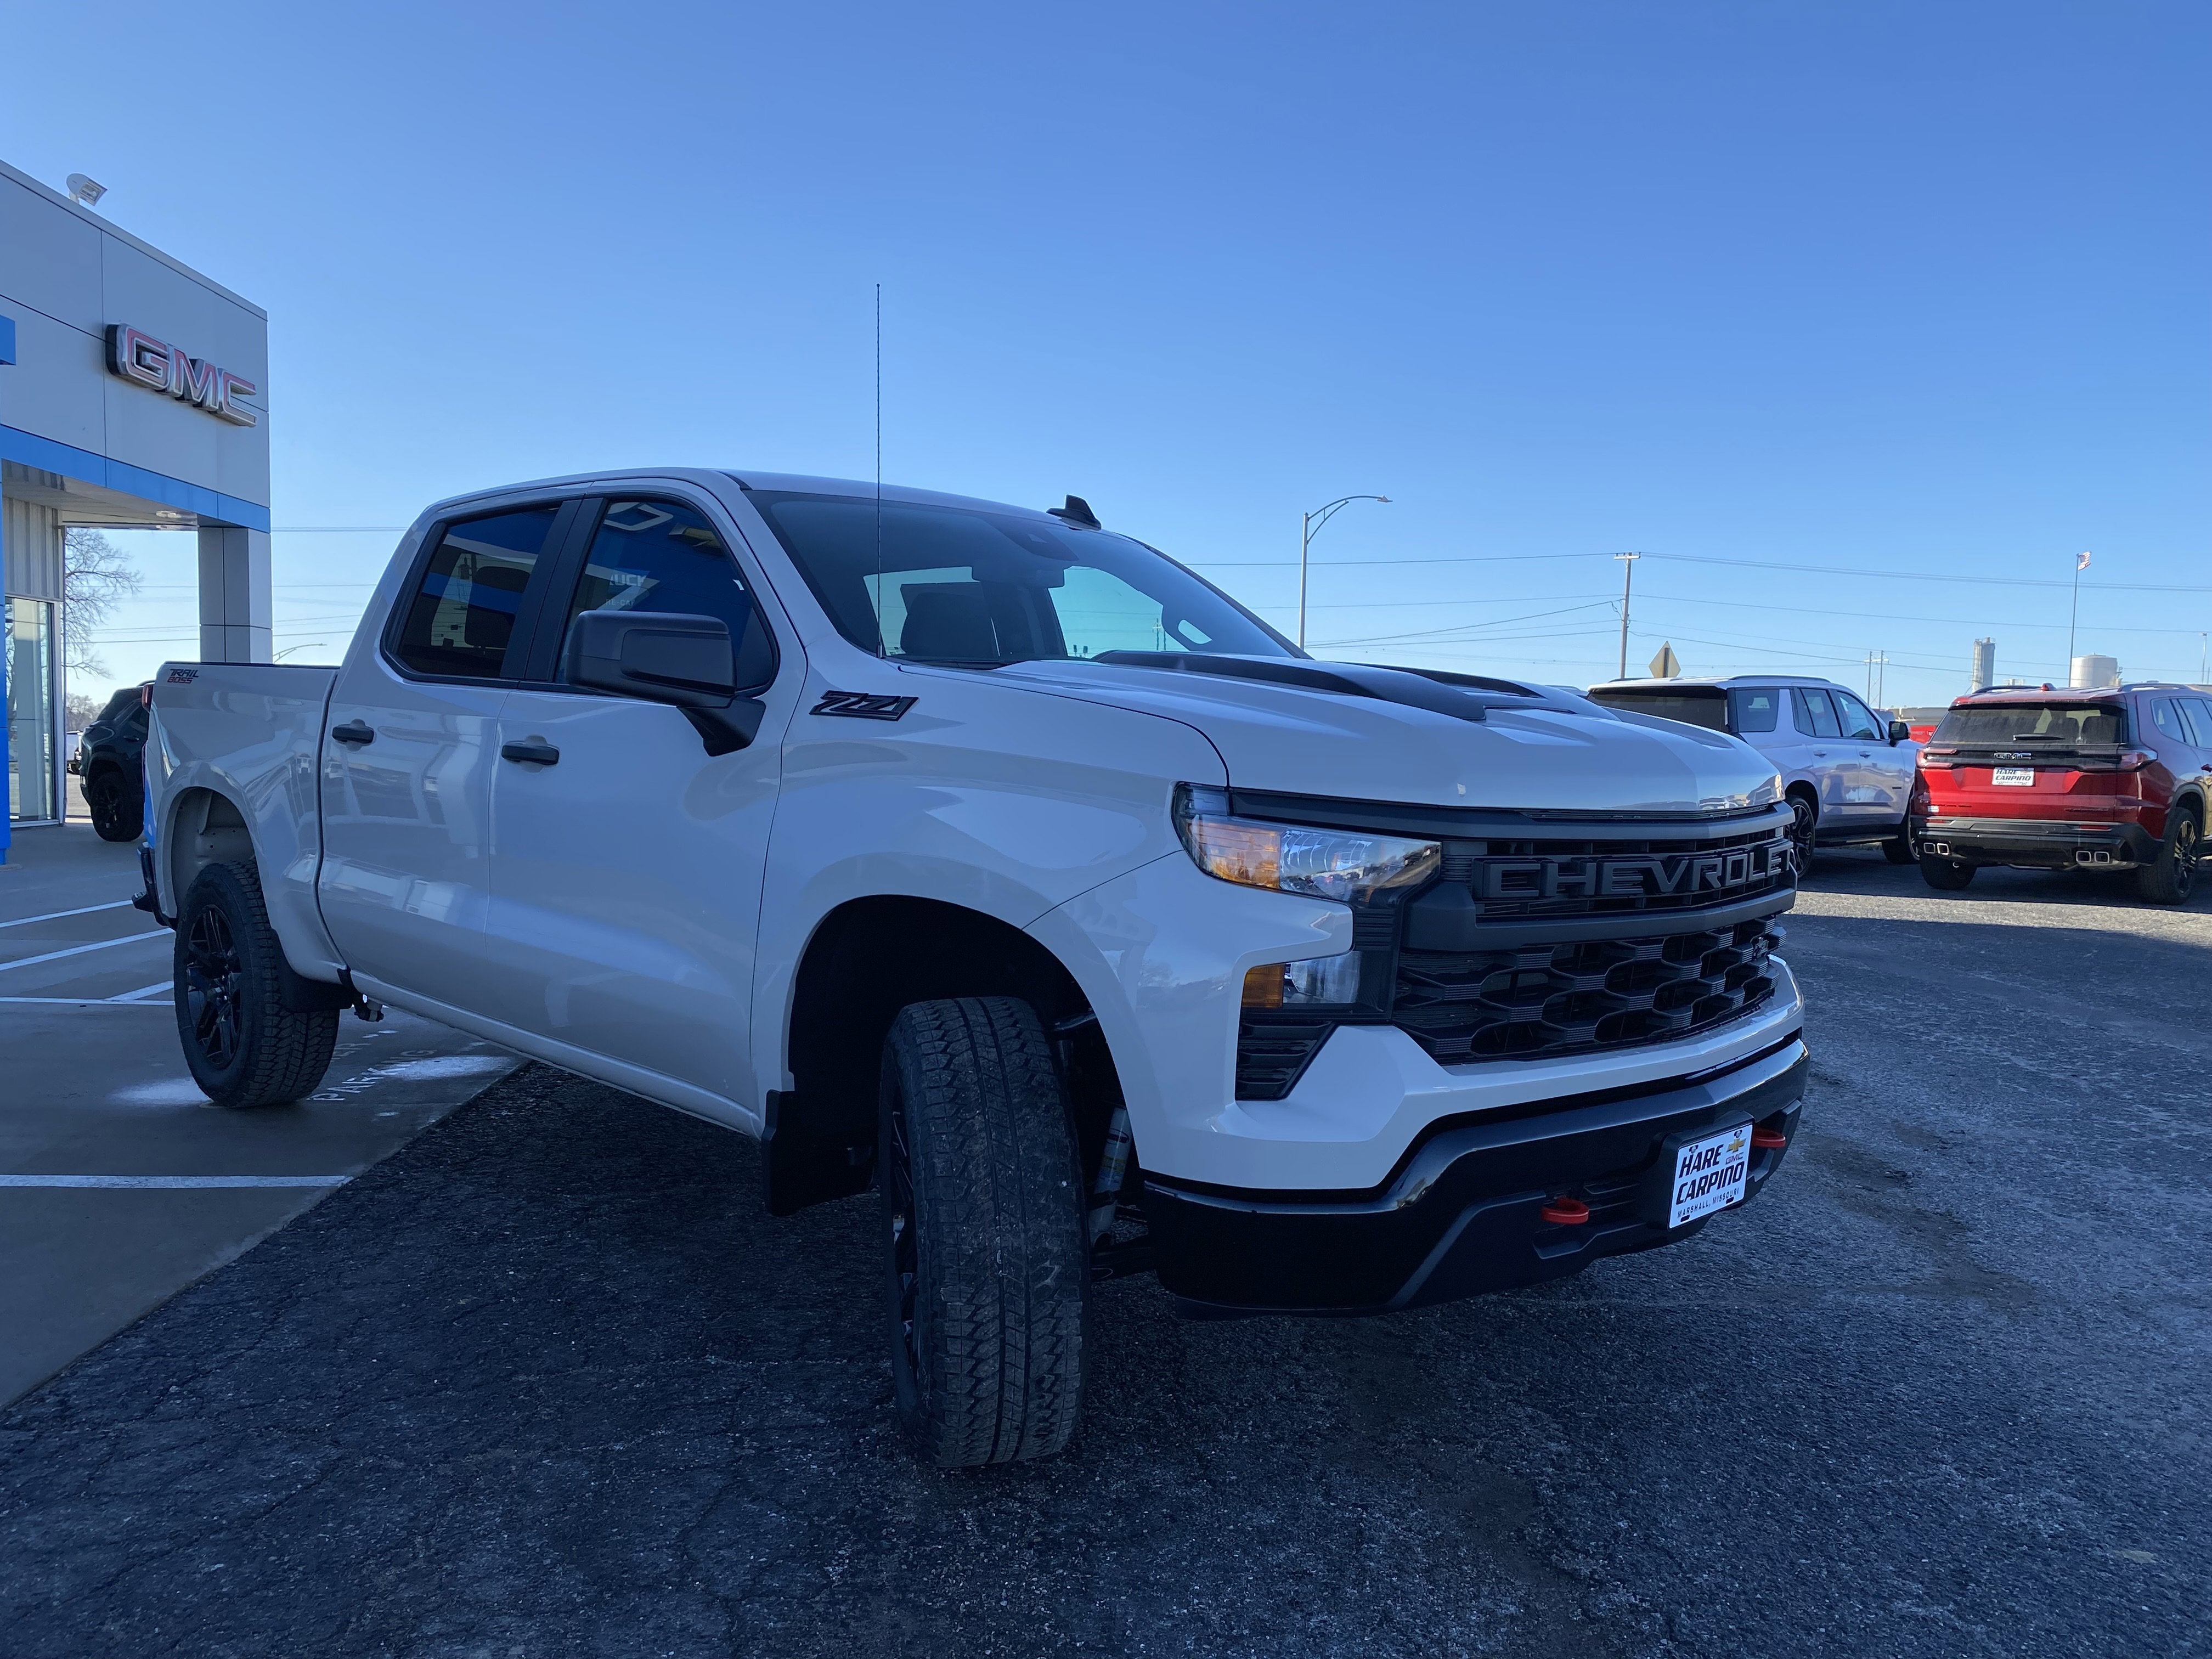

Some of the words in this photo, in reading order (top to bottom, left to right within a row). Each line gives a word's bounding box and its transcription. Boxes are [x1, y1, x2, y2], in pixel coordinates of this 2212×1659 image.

[111, 323, 257, 427] GMC
[170, 669, 199, 678] TRAIL
[809, 690, 919, 721] Z71
[1679, 1143, 1724, 1178] HARE
[1725, 1152, 1743, 1165] GMC
[1675, 1160, 1745, 1205] CARPINO
[1712, 1187, 1740, 1204] MISSOURI
